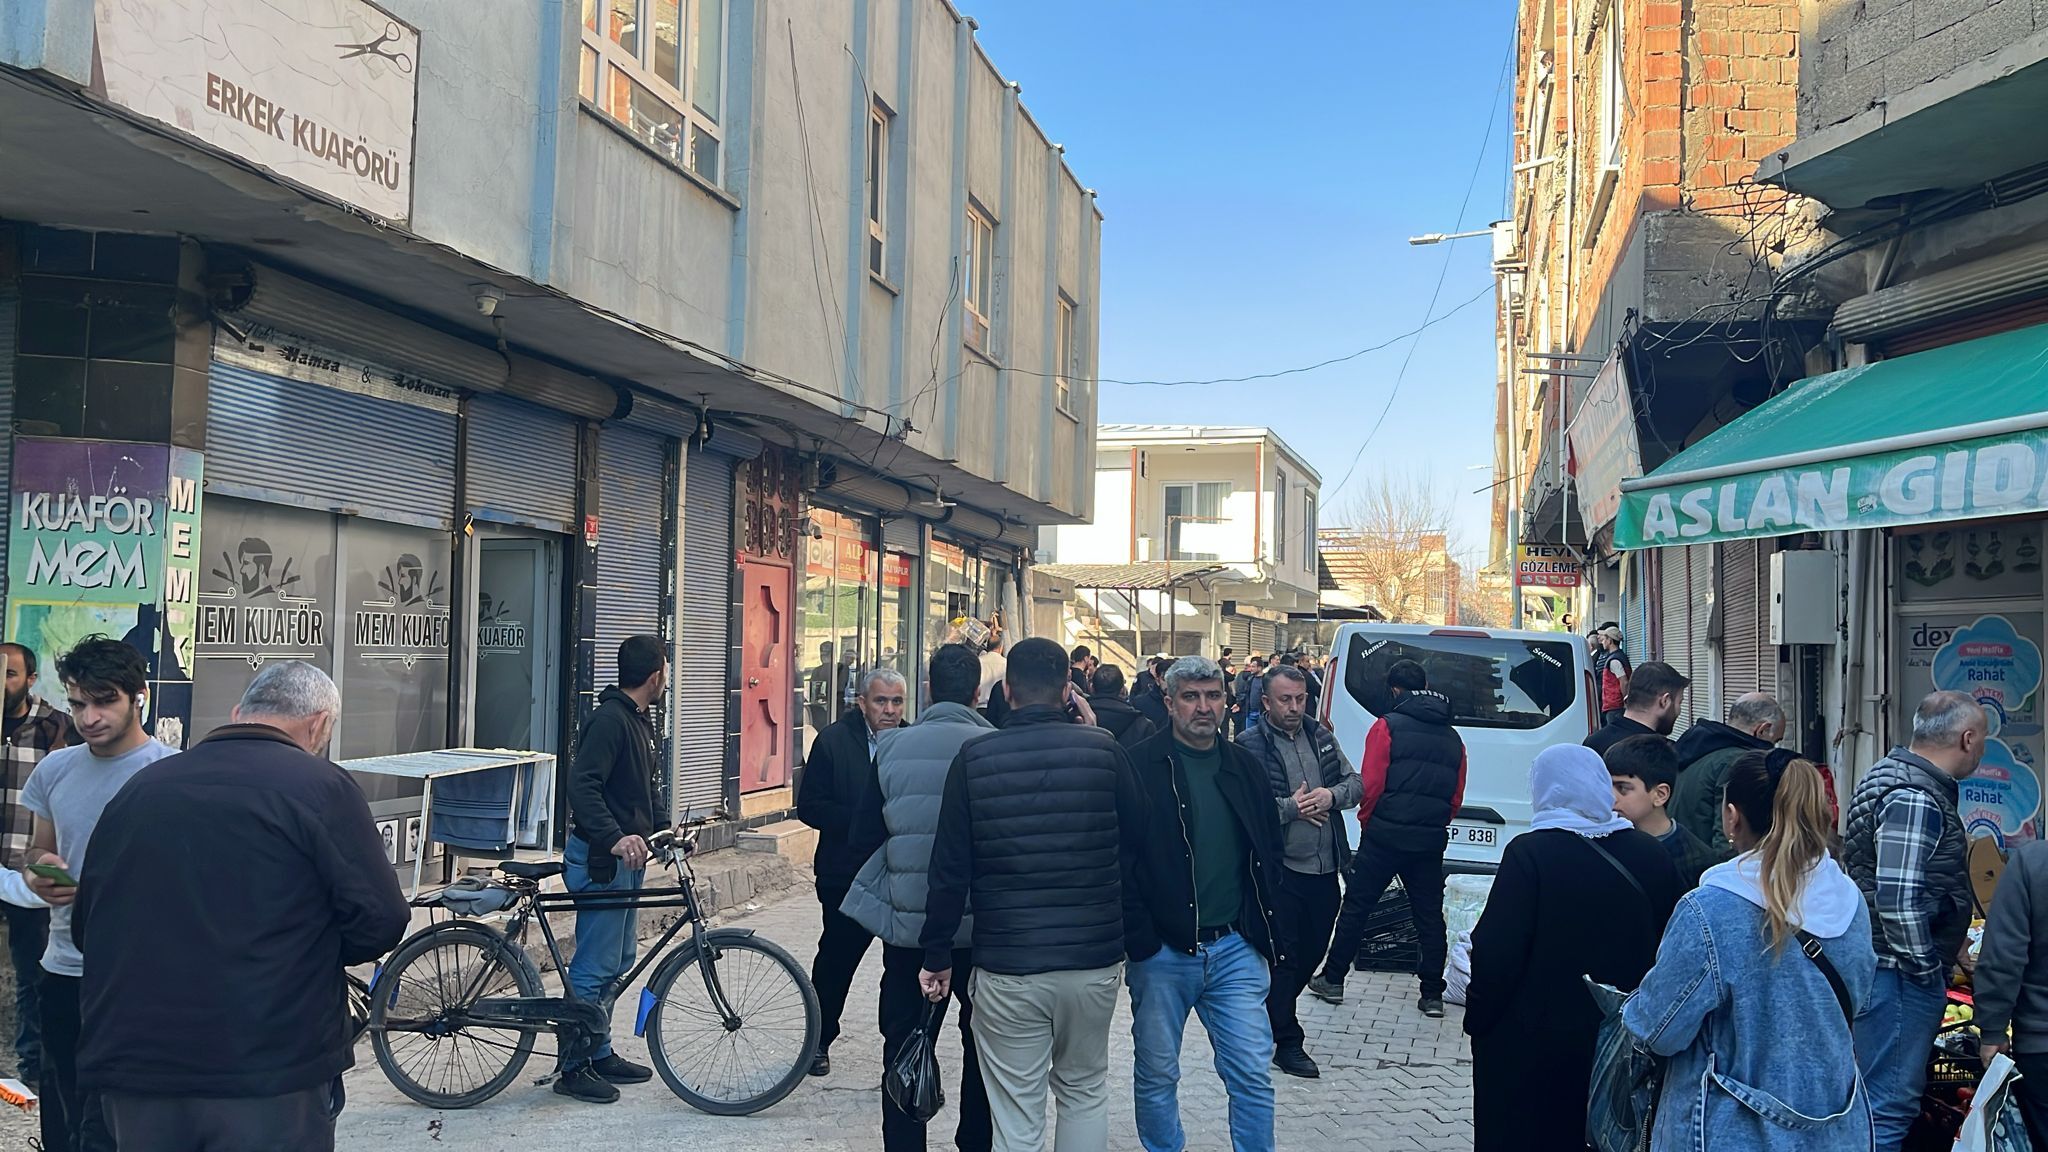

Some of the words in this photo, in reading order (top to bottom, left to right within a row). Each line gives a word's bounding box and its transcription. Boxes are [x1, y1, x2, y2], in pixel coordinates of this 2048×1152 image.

[206, 71, 285, 141] ERKEK
[293, 113, 400, 191] KUAFÖRÜ
[278, 344, 340, 373] Hamza
[361, 365, 371, 384] &
[20, 485, 156, 536] KUAFÖR
[1642, 466, 1851, 542] ASLAN
[1879, 442, 2048, 516] GID
[1520, 559, 1578, 574] GÖZLEME
[244, 603, 324, 646] KUAFÖR
[354, 611, 397, 648] MEM
[401, 610, 450, 649] KUAFÖ
[1361, 639, 1388, 660] Hamza
[1967, 668, 2006, 682] Rahat
[1965, 788, 2004, 805] Rahat
[1468, 829, 1493, 843] 838
